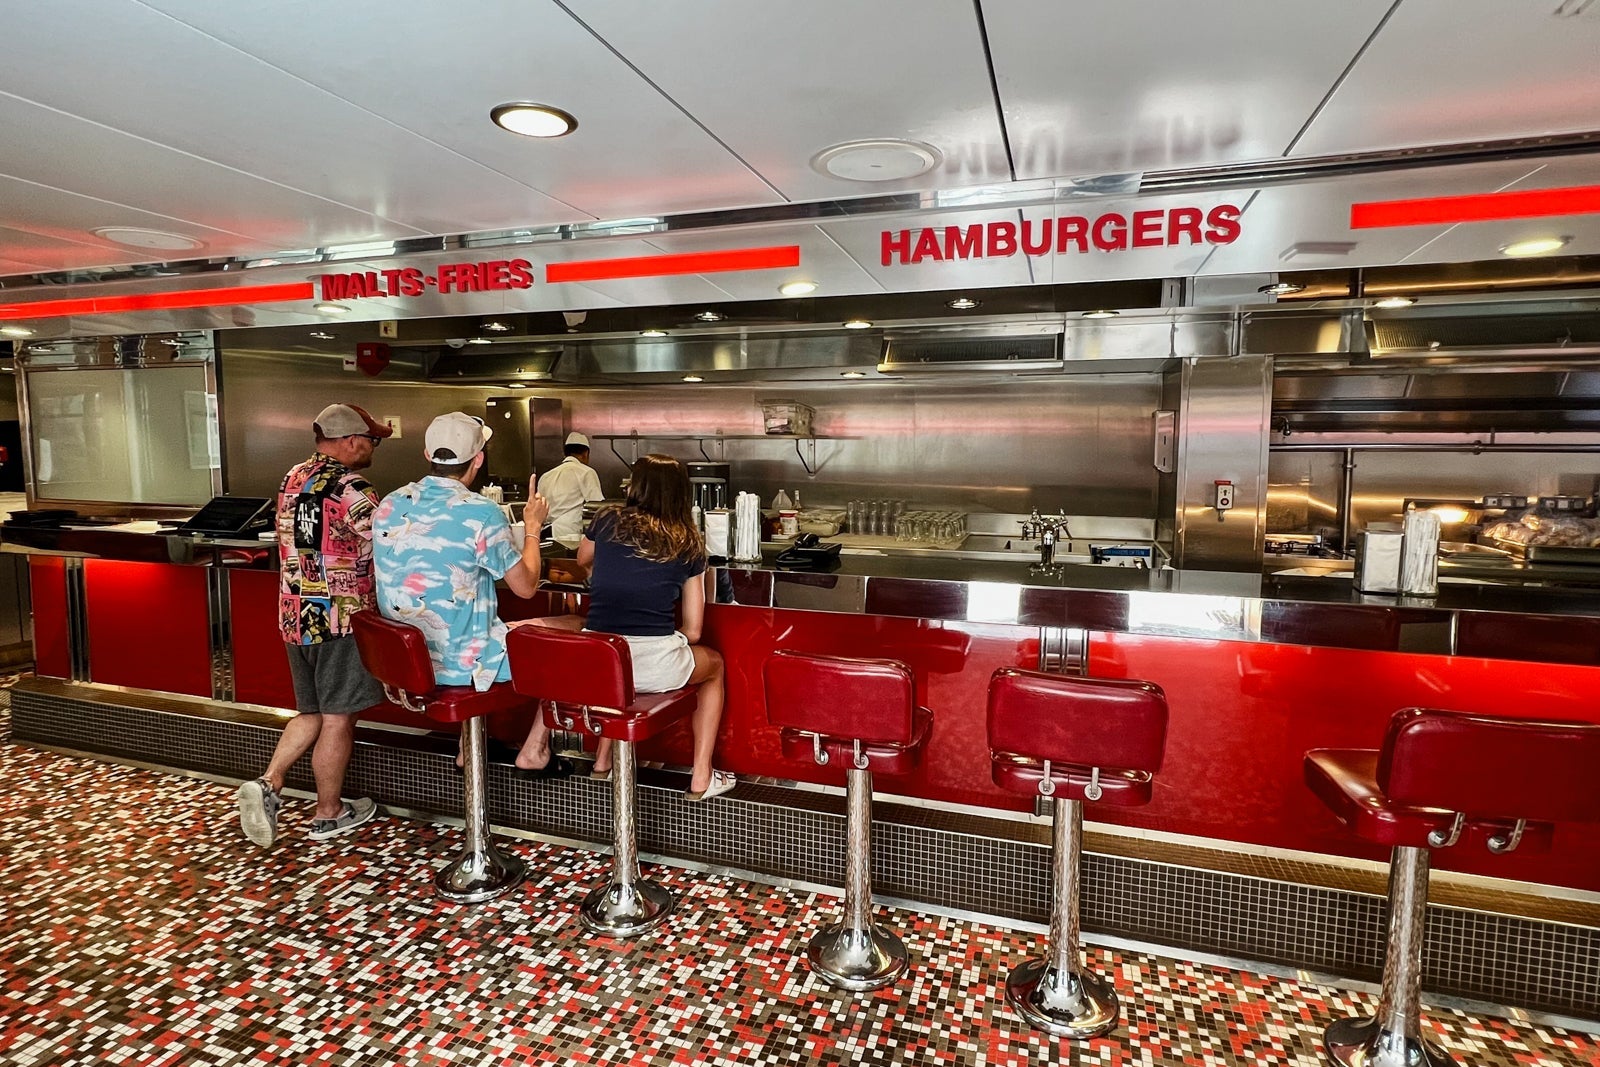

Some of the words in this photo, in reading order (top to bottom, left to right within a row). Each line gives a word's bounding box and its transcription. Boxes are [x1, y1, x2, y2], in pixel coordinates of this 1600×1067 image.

[880, 204, 1241, 266] HAMBURGERS
[321, 267, 425, 301] MALTS
[437, 259, 534, 294] FRIES
